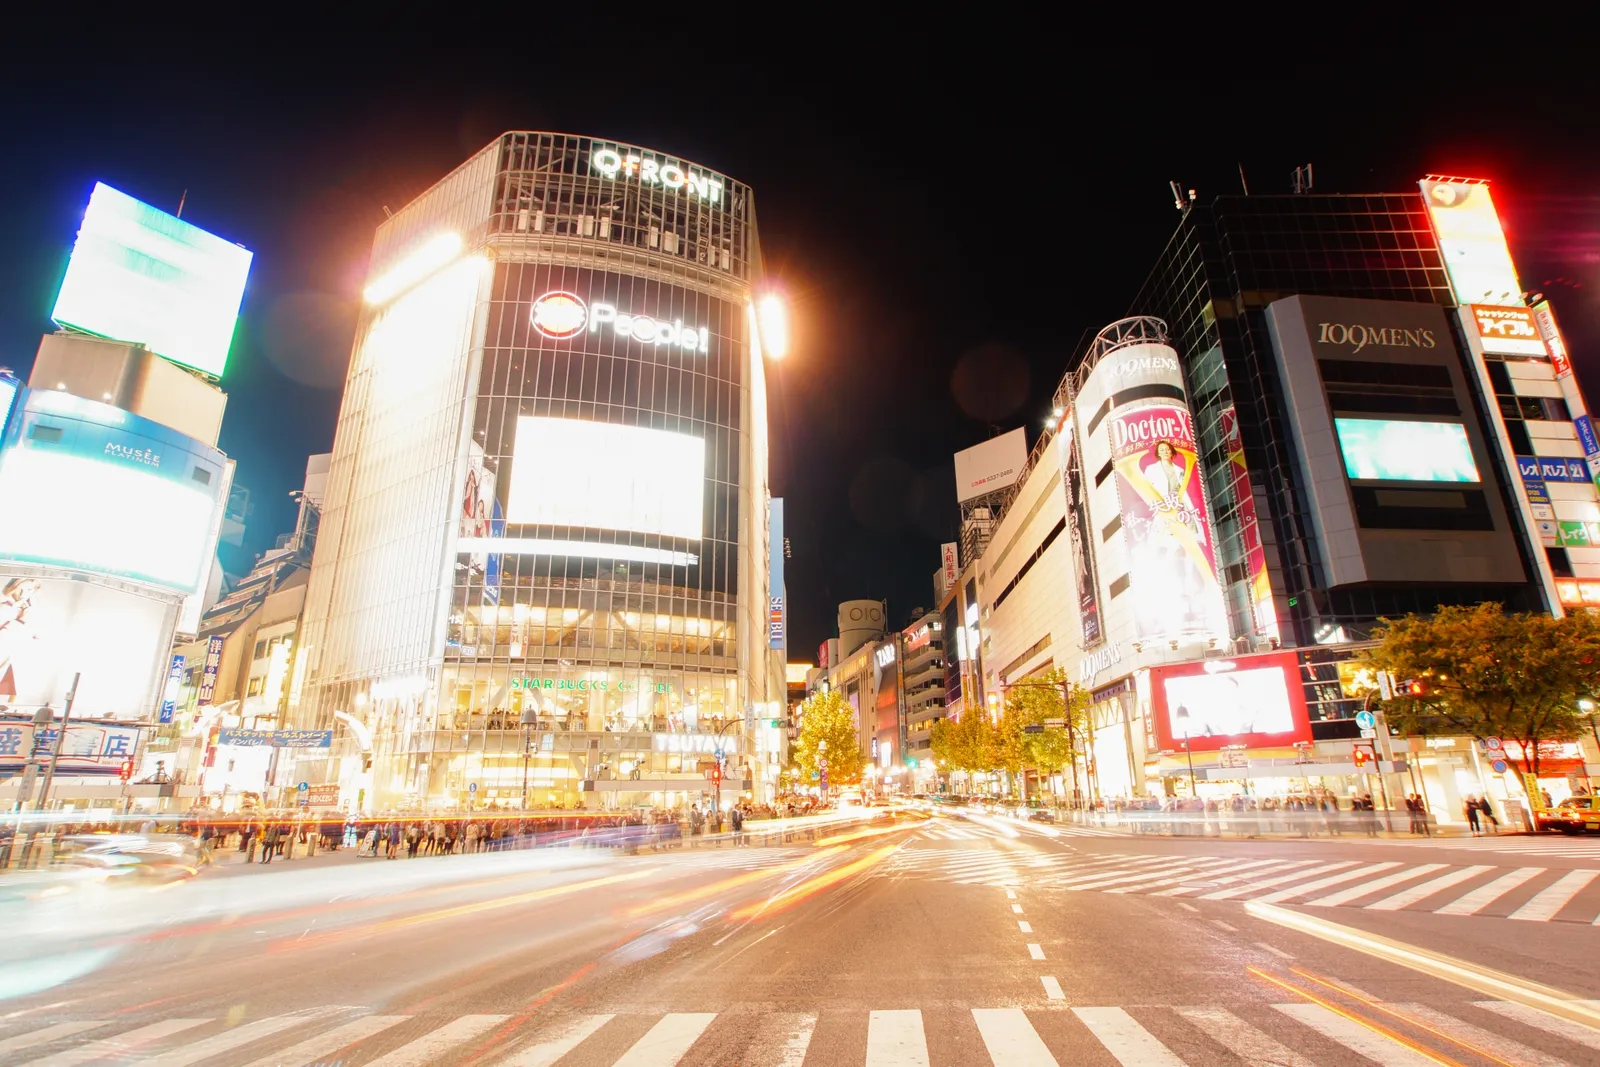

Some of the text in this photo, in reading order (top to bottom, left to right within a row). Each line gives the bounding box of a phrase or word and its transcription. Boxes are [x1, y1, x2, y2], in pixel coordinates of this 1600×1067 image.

[593, 149, 722, 202] QFRONT
[1317, 322, 1436, 354] 109MEN'S
[1478, 319, 1535, 336] アイフル
[1113, 410, 1192, 449] Doctor-X
[771, 597, 782, 639] SEIBU
[200, 639, 222, 700] 洋服の青山
[876, 643, 895, 667] ZARA
[511, 678, 608, 692] STARBUCKS
[655, 734, 736, 753] TSUTAYA
